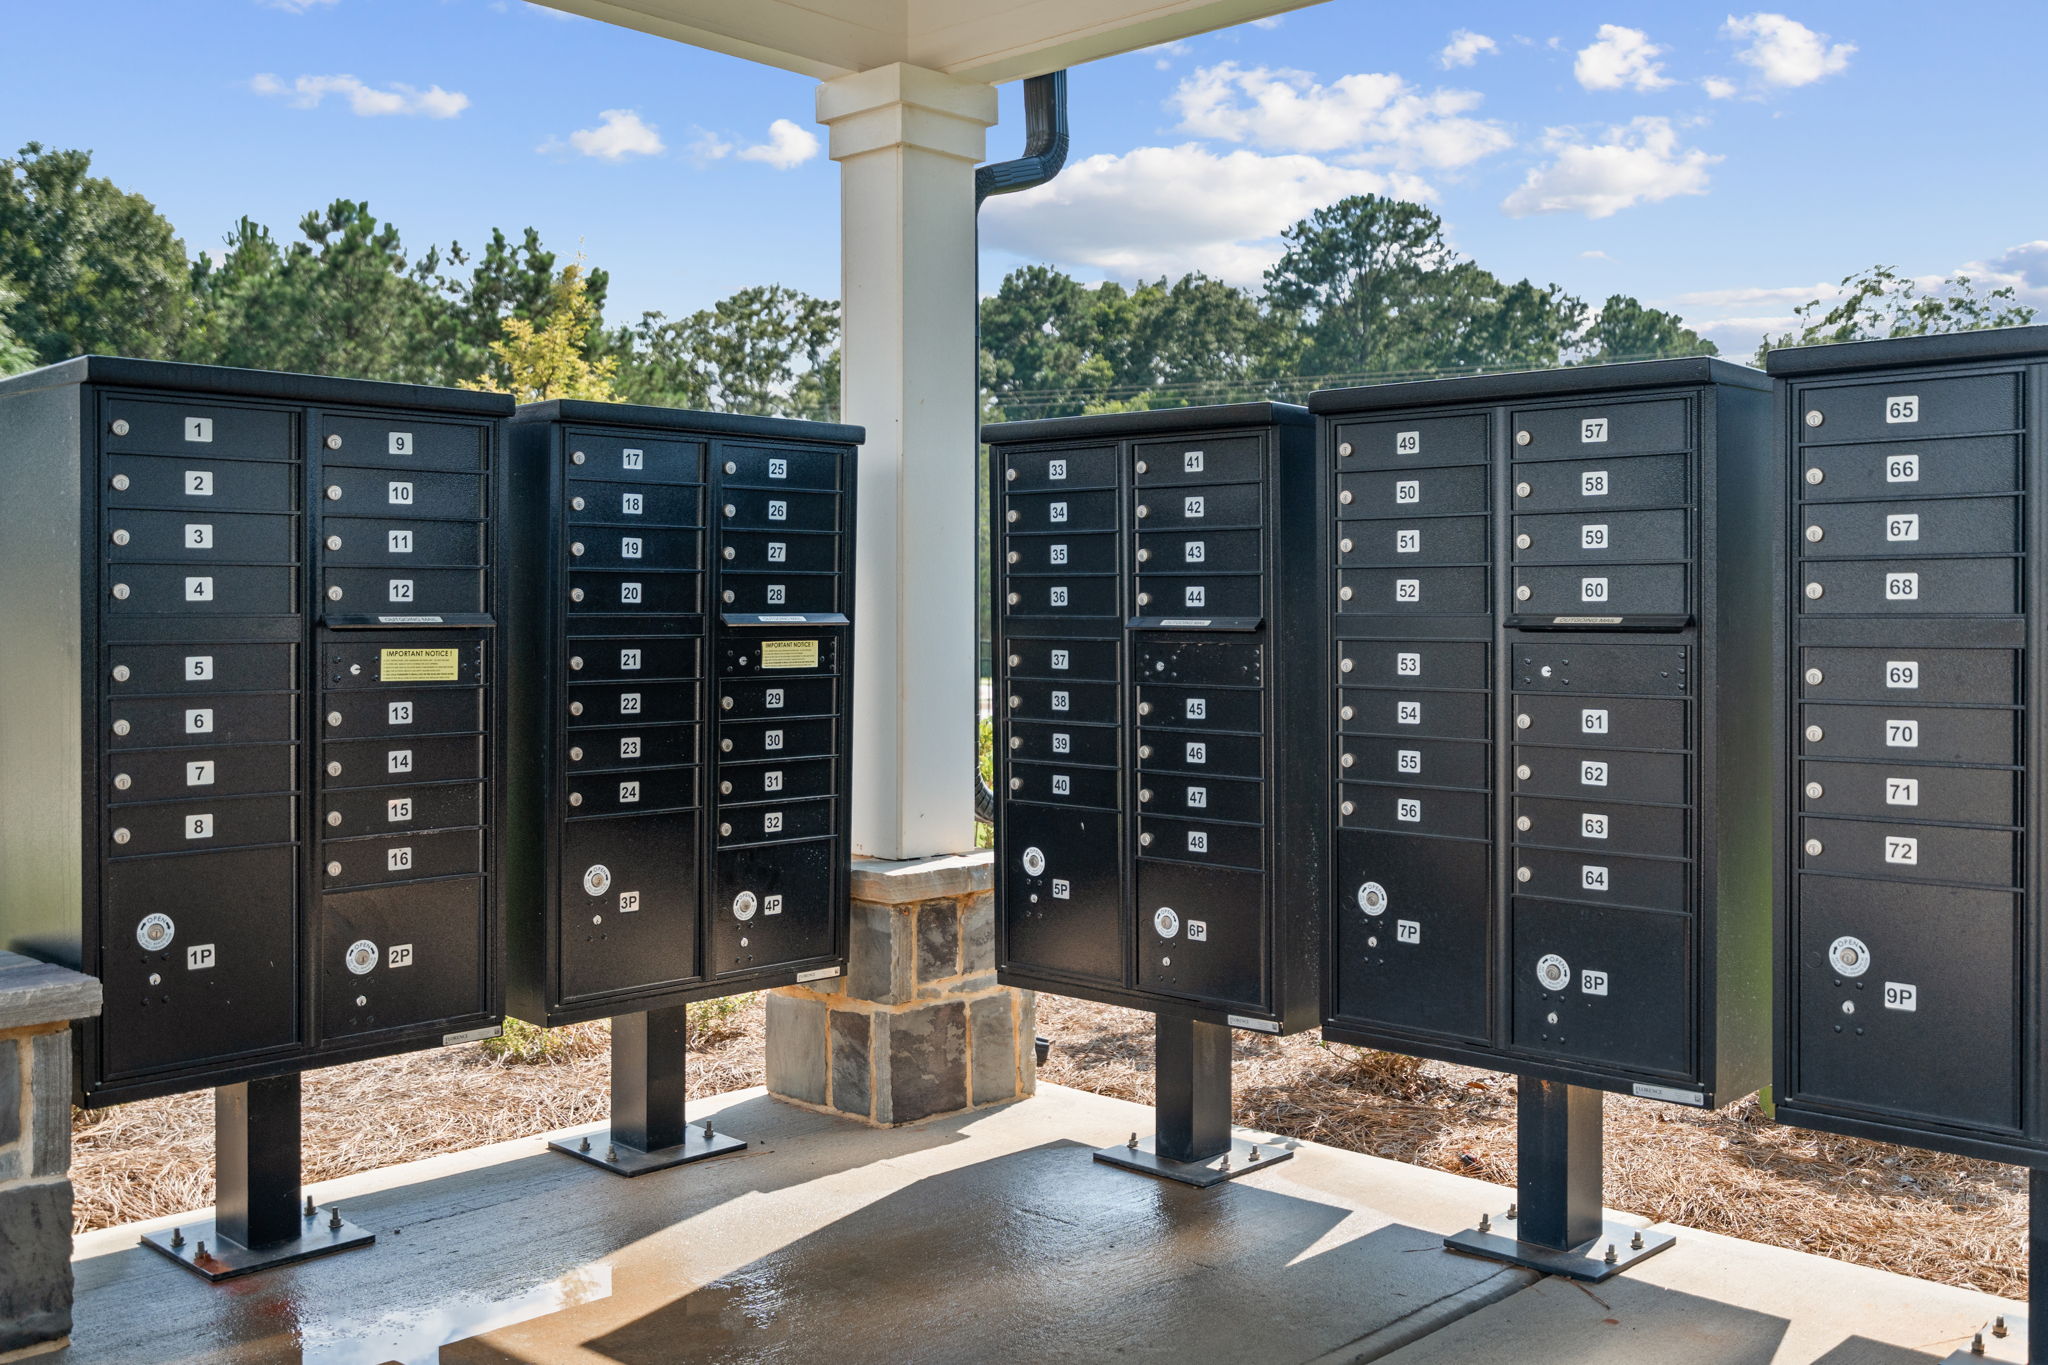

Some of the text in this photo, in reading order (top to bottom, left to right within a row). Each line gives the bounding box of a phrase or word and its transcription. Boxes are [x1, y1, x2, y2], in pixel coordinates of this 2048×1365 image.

[1890, 401, 1914, 419] 65
[194, 422, 201, 437] 1
[1585, 423, 1604, 439] 57
[395, 436, 405, 451] 9
[1399, 436, 1416, 451] 49
[625, 453, 640, 466] 17
[1186, 455, 1199, 469] 41
[770, 462, 784, 475] 25
[1051, 464, 1064, 477] 33
[1890, 461, 1914, 478] 66
[193, 476, 204, 491] 2
[1585, 476, 1604, 492] 58
[392, 486, 409, 501] 10
[1399, 485, 1416, 500] 50
[625, 497, 640, 511] 18
[770, 504, 784, 517] 26
[1187, 500, 1201, 514] 42
[1052, 506, 1065, 519] 34
[1890, 520, 1913, 537] 67
[194, 529, 204, 544] 3
[392, 535, 408, 549] 11
[1400, 534, 1415, 549] 51
[1585, 529, 1604, 545] 59
[624, 541, 639, 555] 19
[769, 546, 783, 559] 27
[1052, 548, 1065, 561] 35
[1187, 545, 1202, 559] 43
[193, 581, 204, 596] 4
[392, 584, 410, 598] 12
[623, 587, 638, 600] 20
[1399, 584, 1416, 598] 52
[1585, 582, 1604, 598] 60
[1889, 579, 1913, 595] 68
[769, 588, 783, 601] 28
[1052, 590, 1066, 603] 36
[1187, 590, 1202, 603] 44
[623, 653, 637, 666] 21
[1053, 654, 1066, 666] 37
[1400, 657, 1417, 672] 53
[194, 661, 204, 676] 5
[1890, 667, 1913, 683] 69
[622, 697, 638, 710] 22
[767, 693, 781, 705] 29
[1054, 695, 1067, 708] 38
[392, 706, 409, 721] 13
[1188, 703, 1203, 716] 45
[1400, 706, 1417, 720] 54
[194, 714, 204, 729] 6
[1585, 714, 1602, 729] 61
[767, 734, 780, 747] 30
[1889, 726, 1913, 742] 70
[622, 741, 638, 755] 23
[1054, 737, 1068, 750] 39
[1188, 747, 1203, 760] 46
[391, 754, 409, 769] 14
[1401, 755, 1417, 769] 55
[195, 766, 205, 781] 7
[1584, 766, 1603, 782] 62
[766, 775, 779, 788] 31
[1054, 779, 1067, 792] 40
[621, 786, 637, 799] 24
[1189, 791, 1204, 804] 47
[1889, 784, 1910, 801] 71
[391, 803, 409, 817] 15
[1401, 803, 1417, 818] 56
[194, 819, 204, 834] 8
[766, 816, 780, 829] 32
[1585, 819, 1604, 834] 63
[1190, 836, 1204, 849] 48
[1889, 842, 1912, 860] 72
[391, 852, 409, 866] 16
[594, 867, 607, 875] OPEN
[1585, 870, 1605, 886] 64
[1054, 883, 1068, 895] 5P
[1368, 885, 1382, 893] OPEN
[621, 895, 637, 909] 3P
[765, 899, 780, 912] 4P
[1189, 924, 1205, 937] 6P
[1399, 924, 1418, 939] 7P
[1838, 939, 1858, 947] OPEN
[190, 949, 212, 965] 1P
[390, 948, 410, 964] 2P
[1550, 957, 1566, 969] OPEN
[1584, 975, 1605, 990] 8P
[1886, 988, 1912, 1005] 9P
